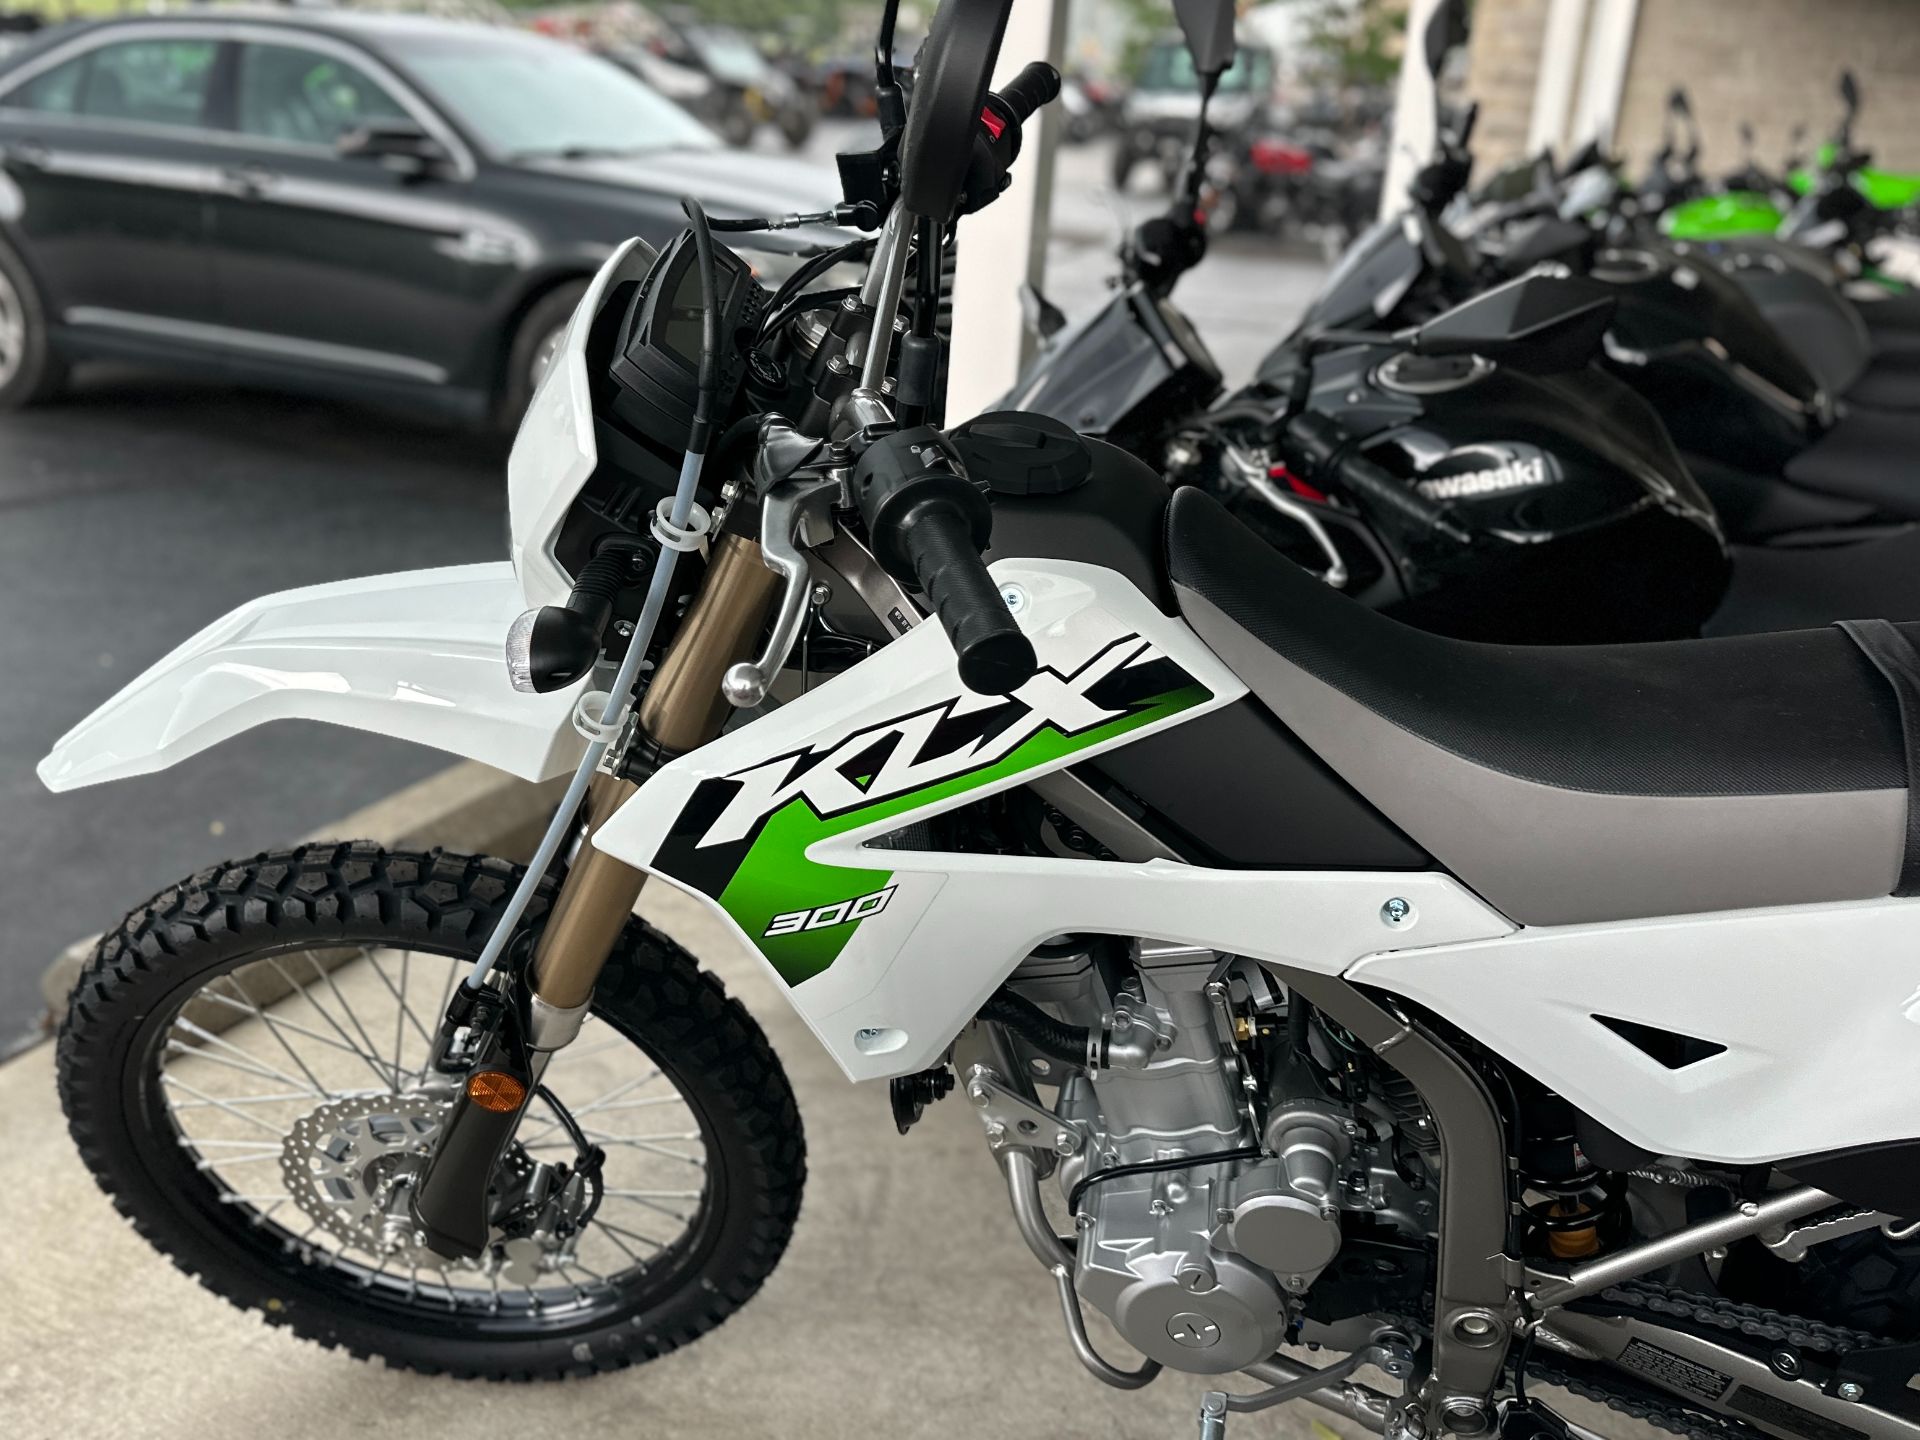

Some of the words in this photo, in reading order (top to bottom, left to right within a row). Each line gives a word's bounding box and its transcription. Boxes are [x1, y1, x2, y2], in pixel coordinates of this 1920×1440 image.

[1409, 457, 1545, 499] awasaki
[694, 633, 1150, 849] KLX
[762, 884, 898, 938] 300
